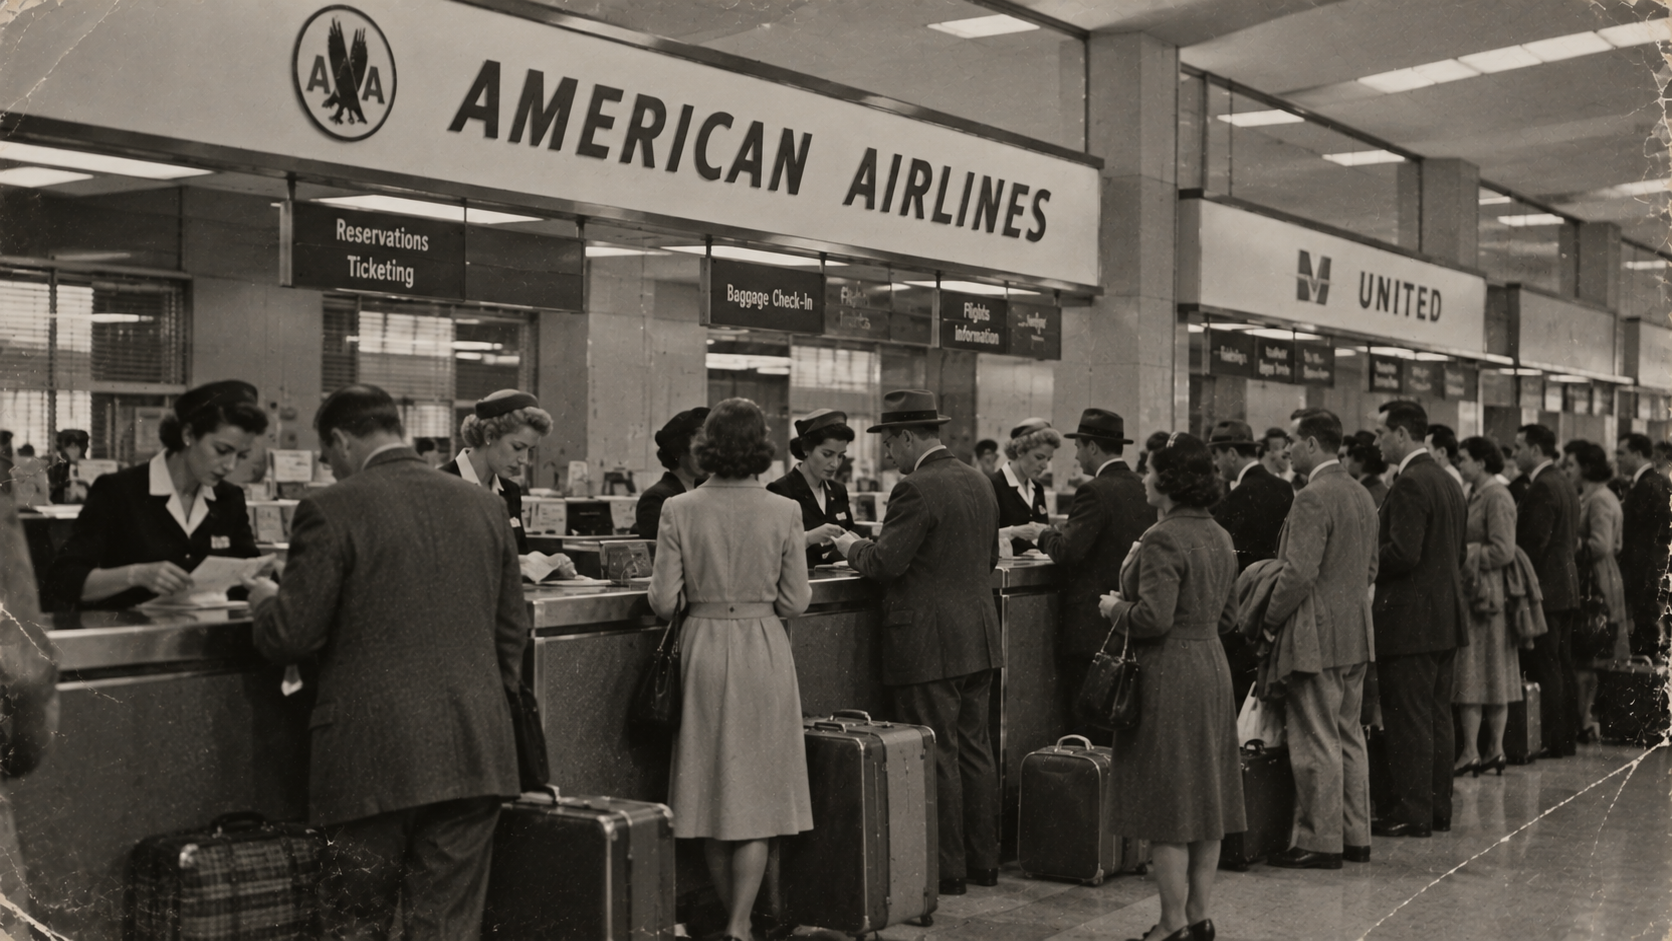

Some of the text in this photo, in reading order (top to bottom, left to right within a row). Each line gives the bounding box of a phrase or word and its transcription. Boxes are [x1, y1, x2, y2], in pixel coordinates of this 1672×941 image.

[306, 54, 385, 105] A A
[447, 59, 1052, 243] AMERICAN AIRLINES
[336, 218, 429, 252] Reservations
[347, 255, 414, 289] Ticketing
[727, 283, 769, 310] Baggage
[772, 288, 814, 311] Check-In
[1359, 270, 1442, 323] UNITED
